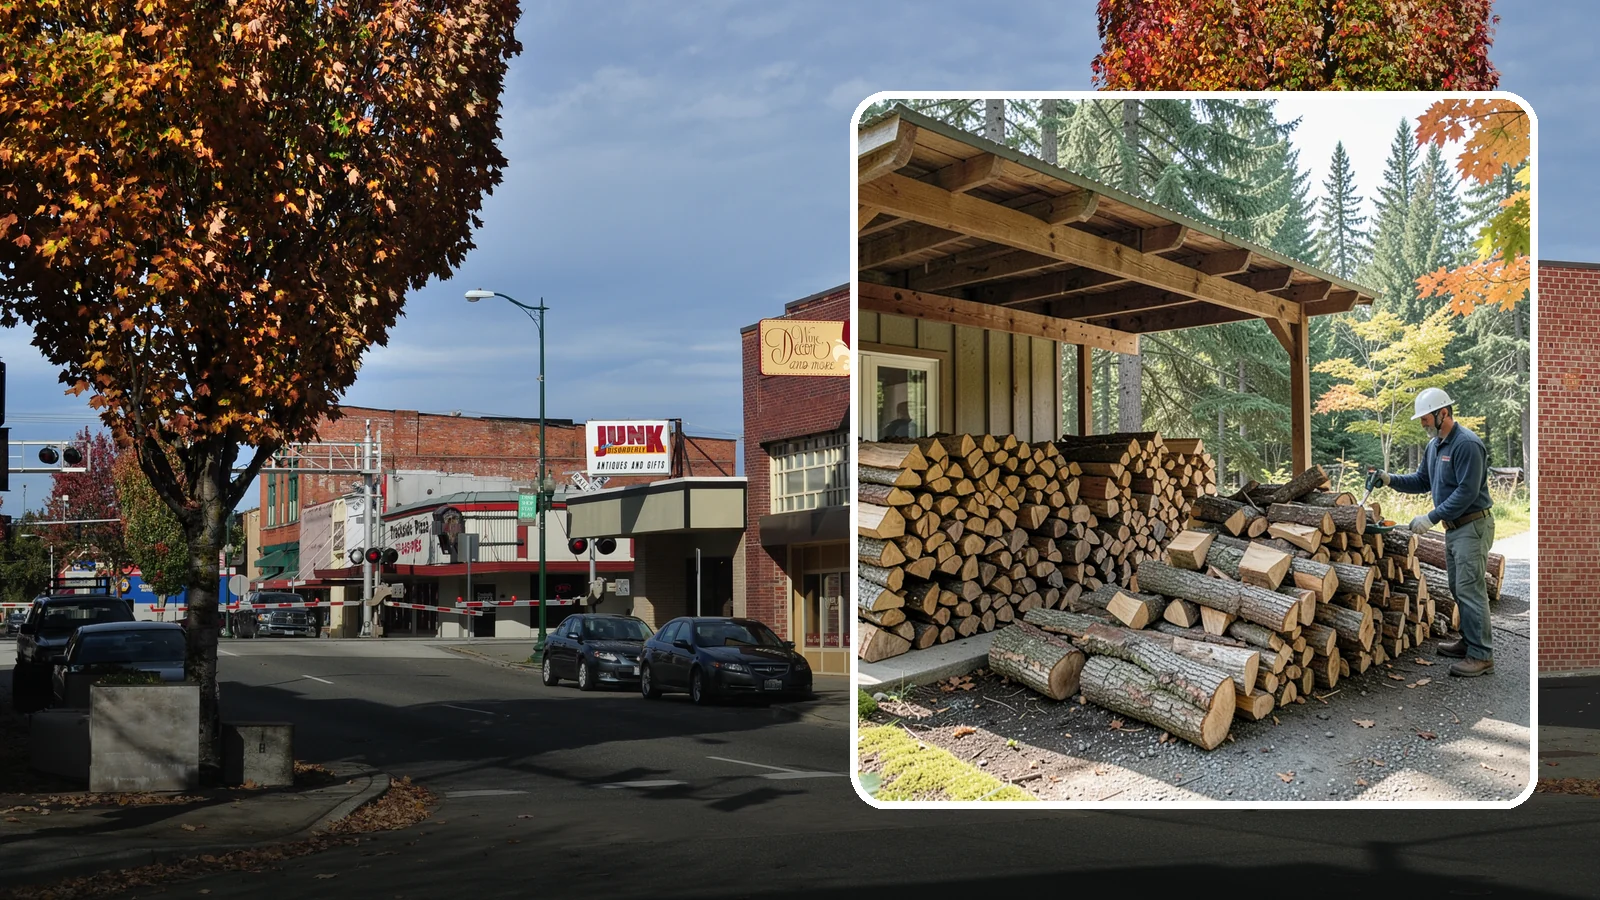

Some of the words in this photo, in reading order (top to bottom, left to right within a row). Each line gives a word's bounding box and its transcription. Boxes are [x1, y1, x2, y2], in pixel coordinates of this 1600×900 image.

[595, 425, 665, 457] JUNK
[607, 446, 646, 454] DISORDERLY
[596, 461, 628, 470] ANTIQUES
[631, 461, 644, 470] AND
[647, 460, 666, 470] GIFTS
[573, 473, 589, 492] RAIL
[414, 519, 429, 535] Pizza
